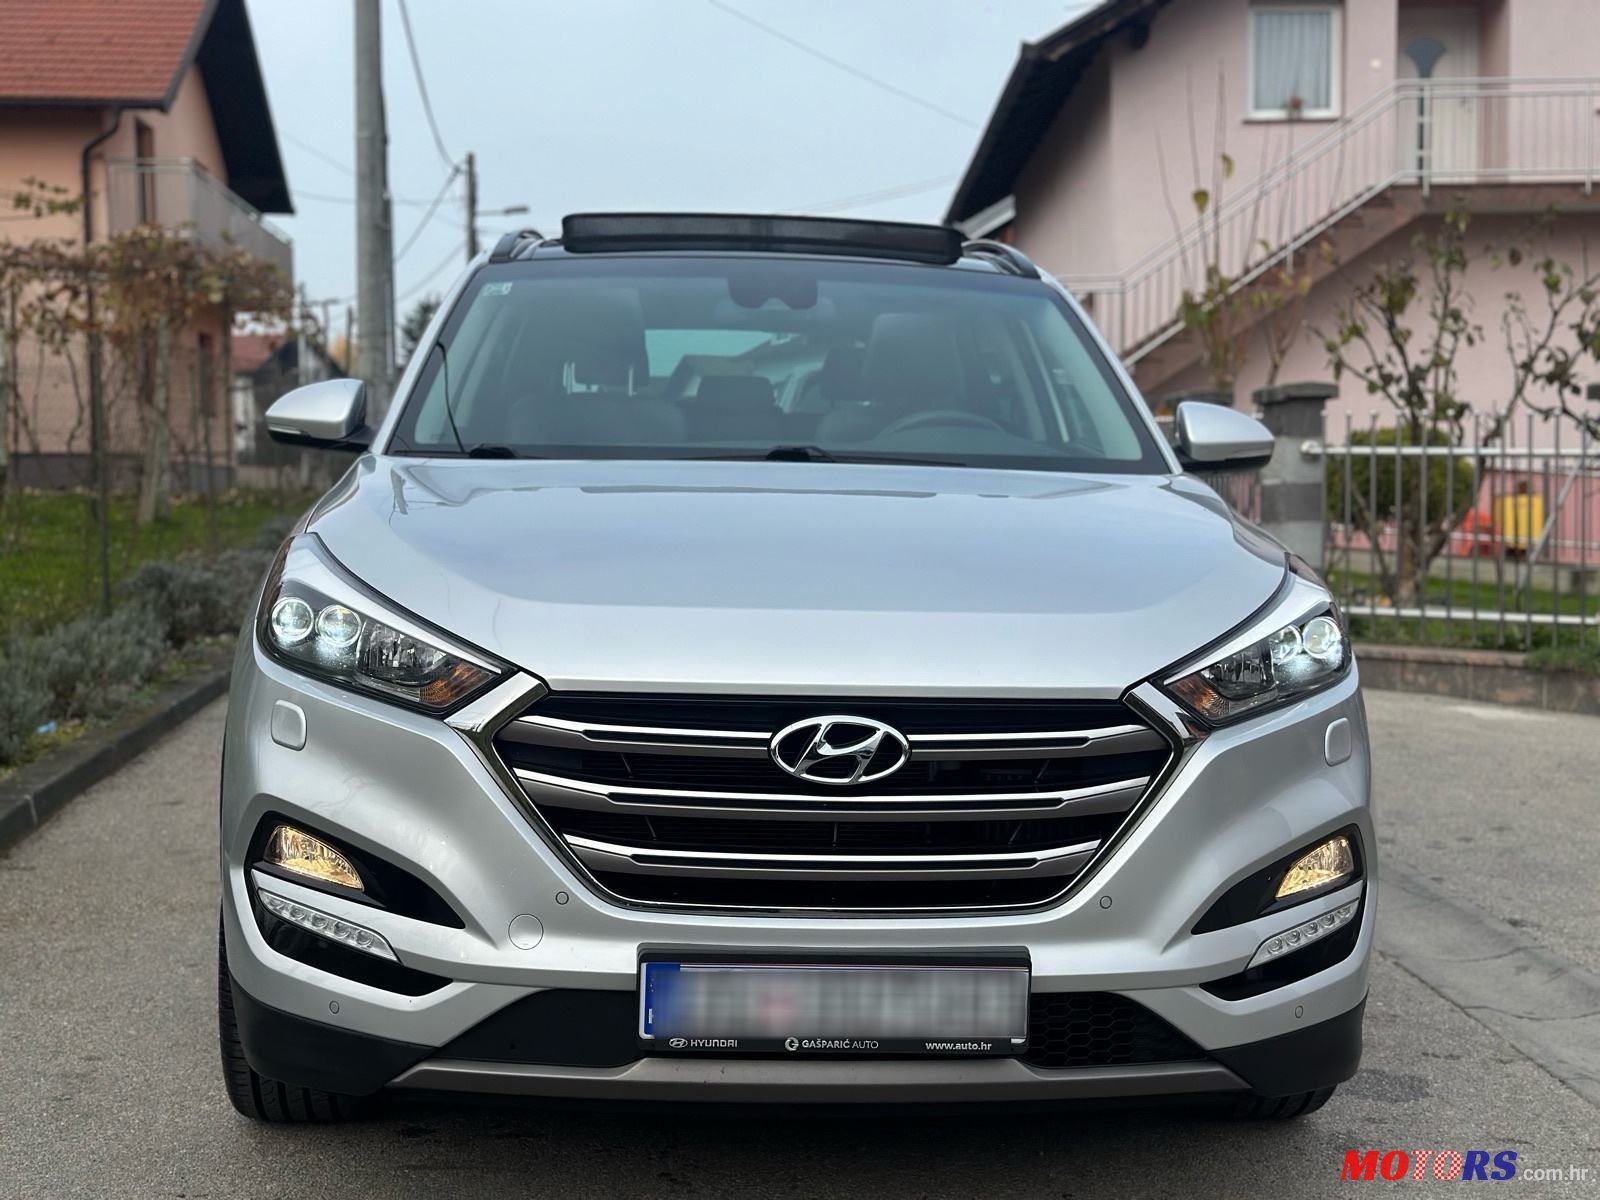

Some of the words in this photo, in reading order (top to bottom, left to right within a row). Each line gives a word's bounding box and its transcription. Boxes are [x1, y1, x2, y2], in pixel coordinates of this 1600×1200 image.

[690, 1039, 738, 1048] HYUNDAI
[802, 1038, 850, 1049] GAŠPARIĆ
[851, 1040, 879, 1049] AUTO
[925, 1041, 993, 1051] www.auto.hr
